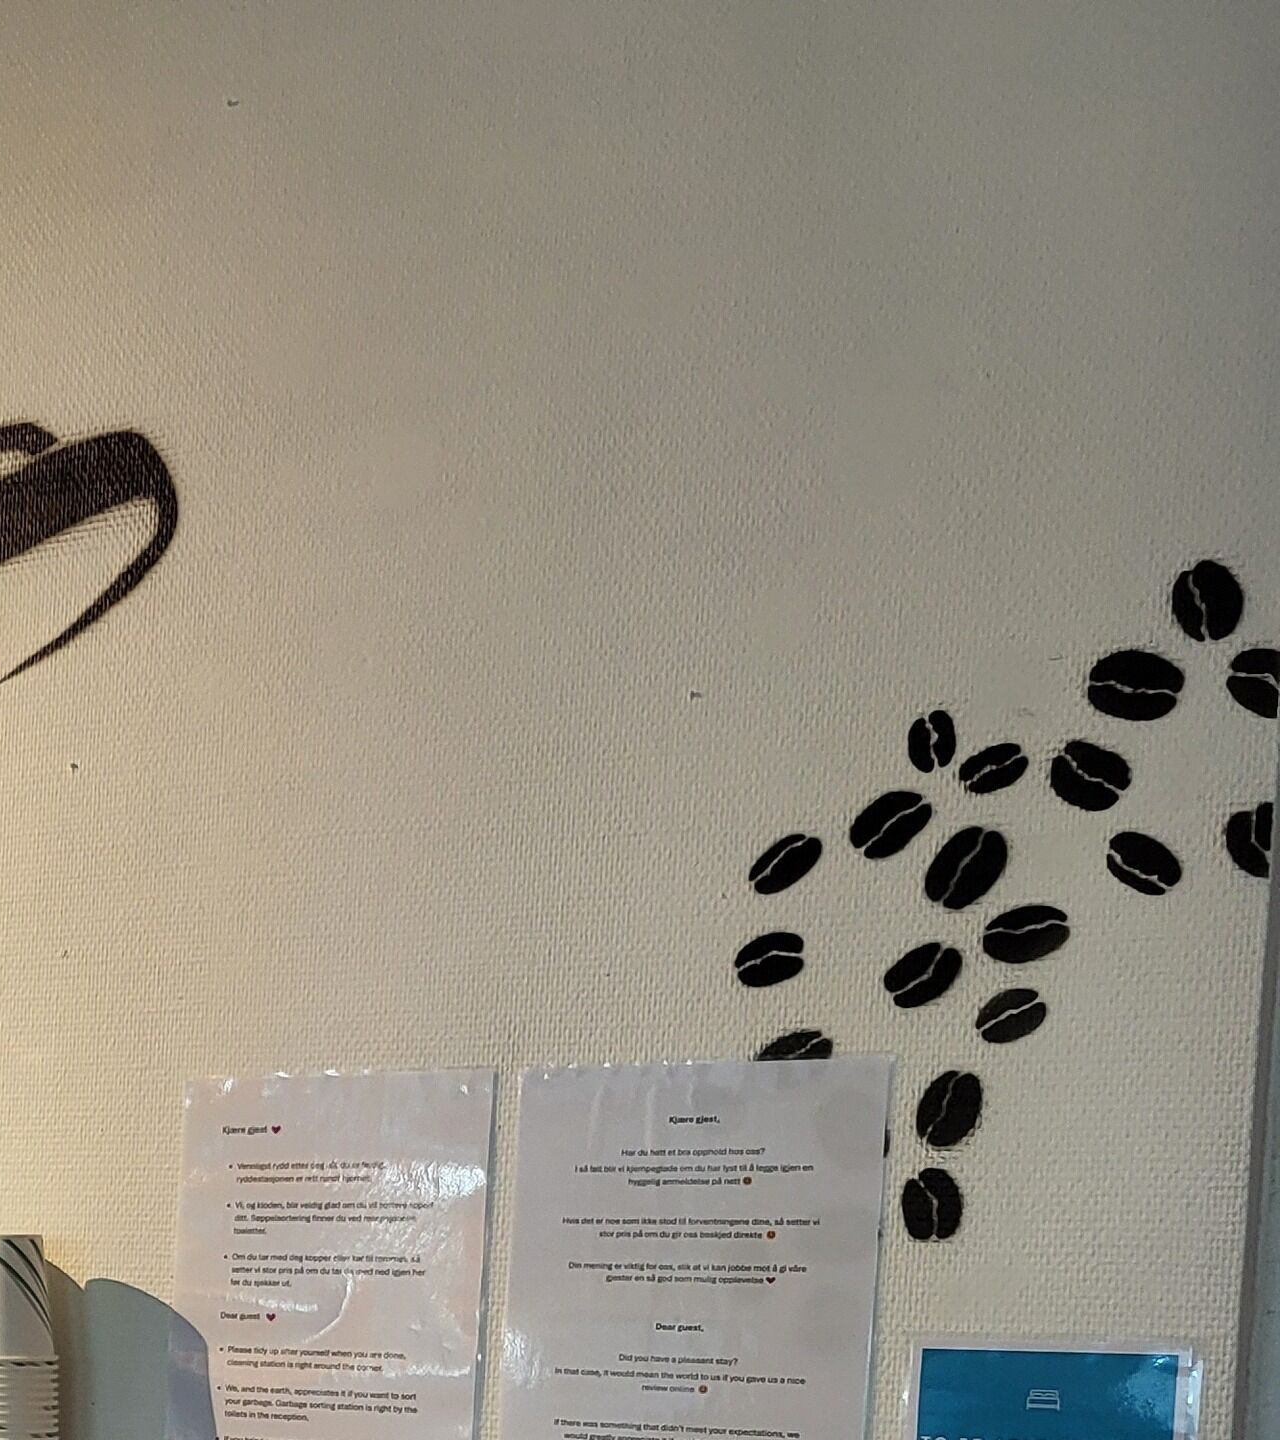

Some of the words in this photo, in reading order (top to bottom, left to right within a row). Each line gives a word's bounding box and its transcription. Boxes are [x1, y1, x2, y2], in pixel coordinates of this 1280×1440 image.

[220, 1312, 238, 1320] Dear
[655, 1323, 675, 1331] Dear
[677, 1324, 704, 1332] guest,
